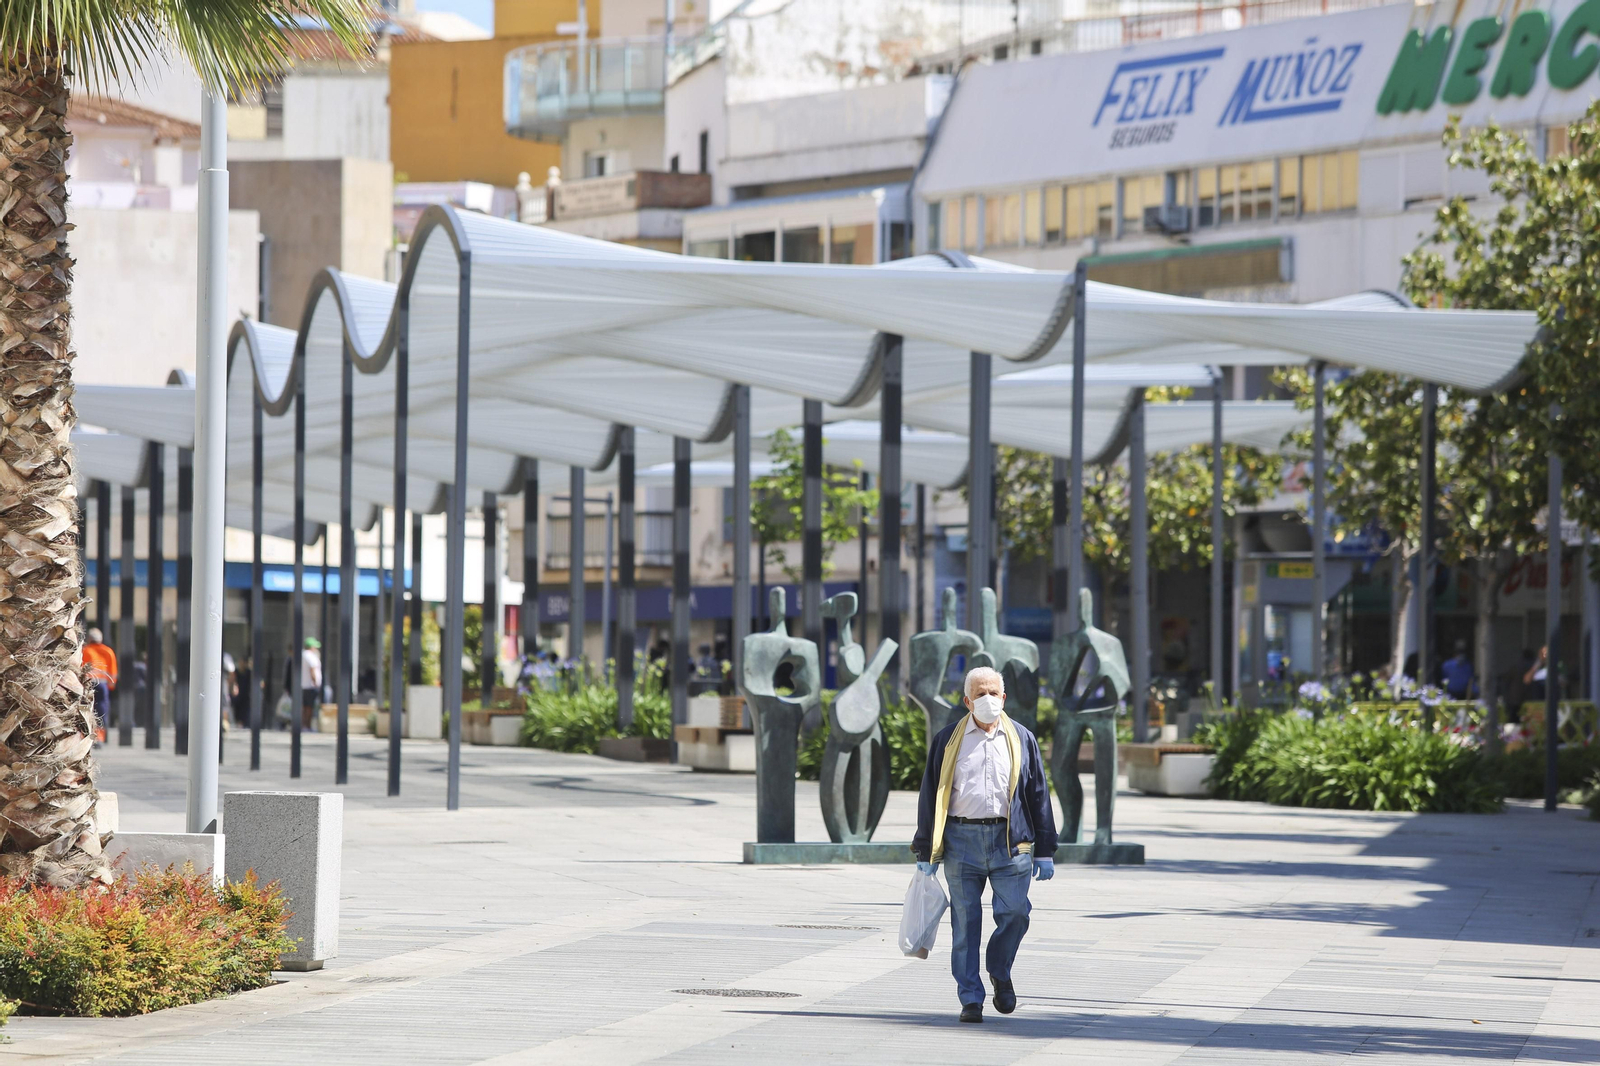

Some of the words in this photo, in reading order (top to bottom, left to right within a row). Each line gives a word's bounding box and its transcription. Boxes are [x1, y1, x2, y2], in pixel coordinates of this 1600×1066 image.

[1092, 46, 1226, 128] FELIX
[1216, 37, 1363, 127] MUÑOZ
[1108, 121, 1177, 150] SEGUROS
